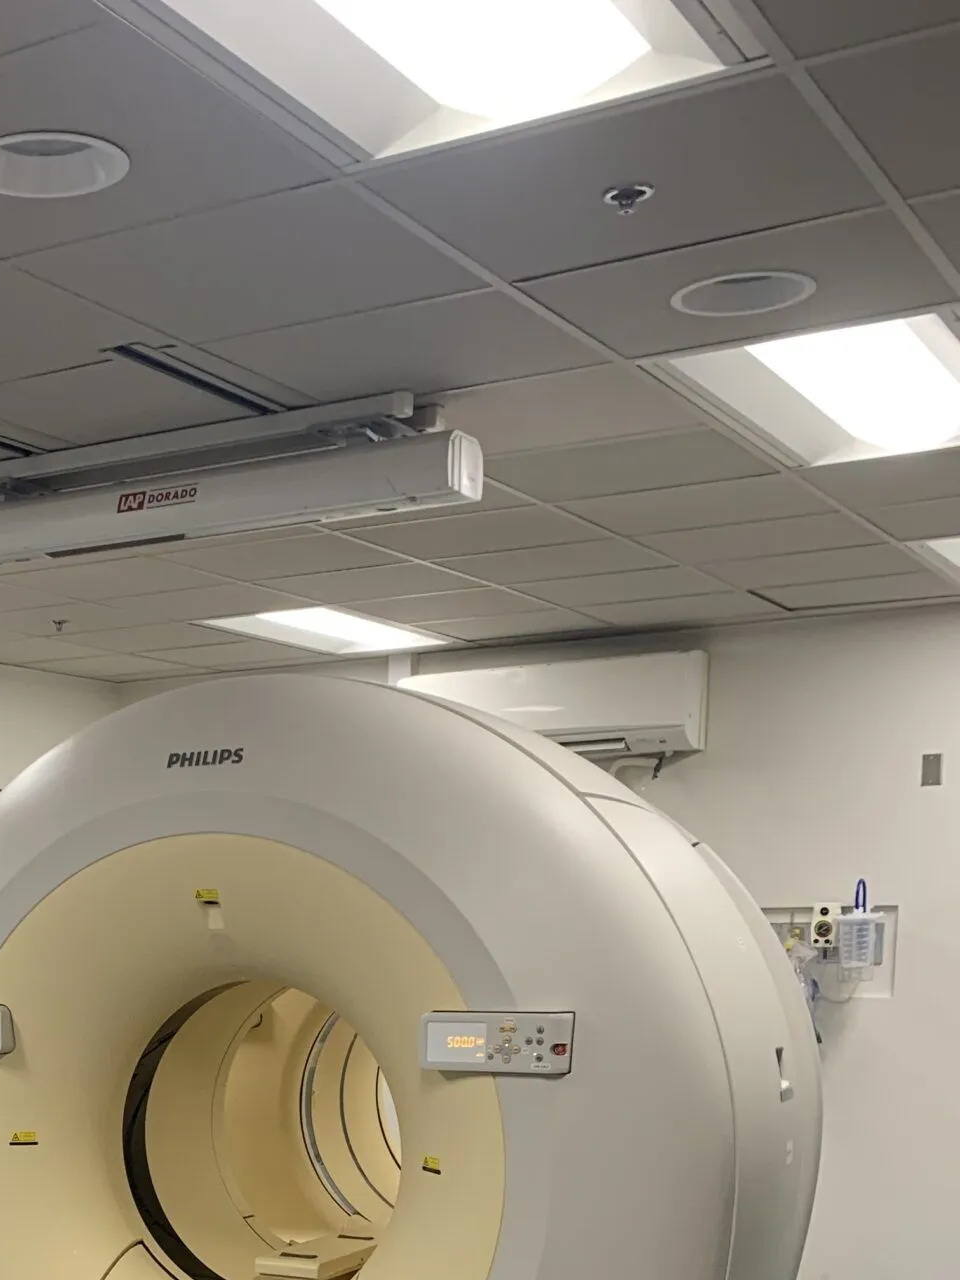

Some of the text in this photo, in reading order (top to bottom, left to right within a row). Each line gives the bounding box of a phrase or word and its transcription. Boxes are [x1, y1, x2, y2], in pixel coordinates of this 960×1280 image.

[119, 487, 198, 511] LAP DORADO
[166, 747, 244, 769] PHILIPS
